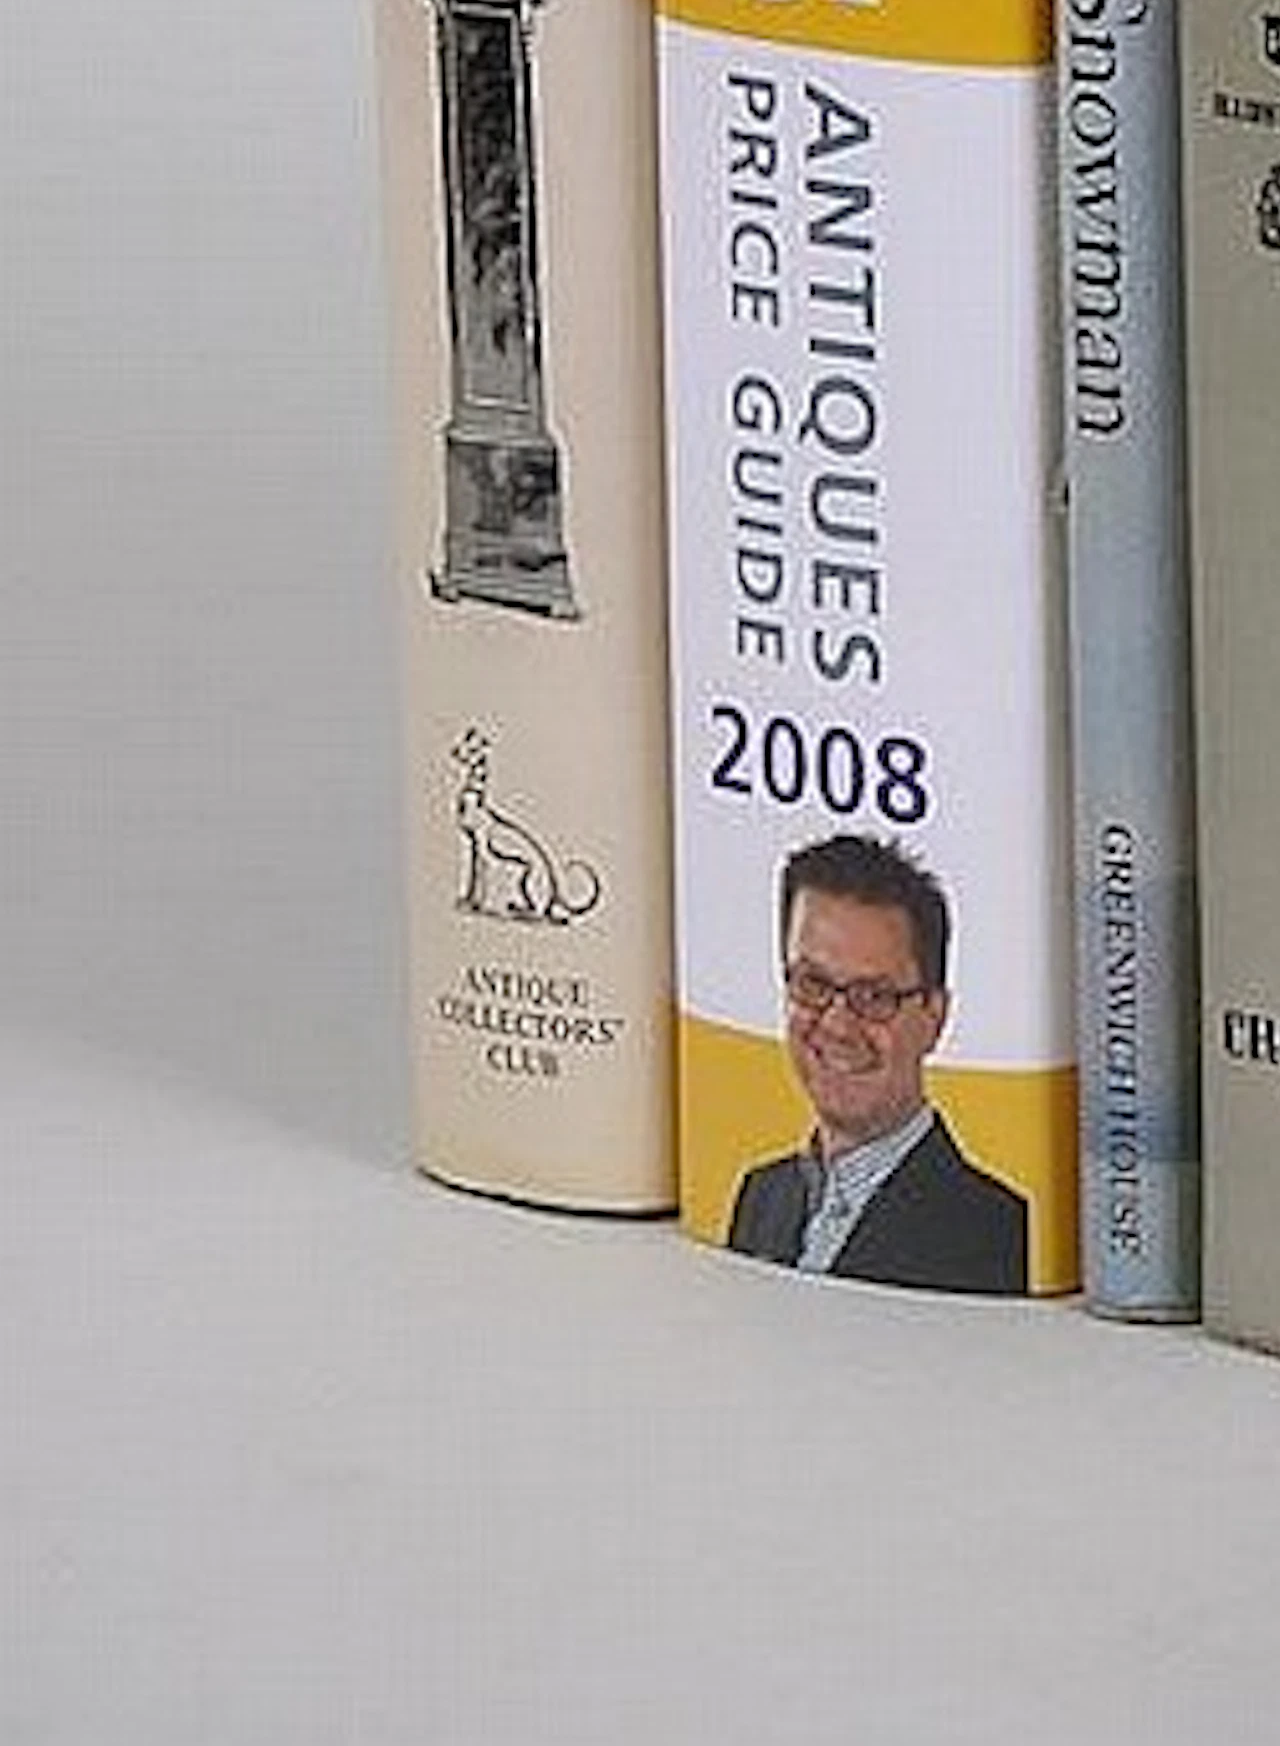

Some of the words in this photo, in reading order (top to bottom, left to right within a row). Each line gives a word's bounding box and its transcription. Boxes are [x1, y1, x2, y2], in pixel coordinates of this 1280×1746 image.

[728, 72, 781, 328] PRICE
[800, 81, 883, 685] ANTIQUES
[732, 374, 786, 665] GUIDE
[710, 704, 930, 826] 2008
[463, 966, 590, 1007] ANTIQUE
[486, 1043, 560, 1076] CLUB
[1102, 822, 1138, 1096] GREENWICH
[1106, 1108, 1142, 1256] HOUSE
